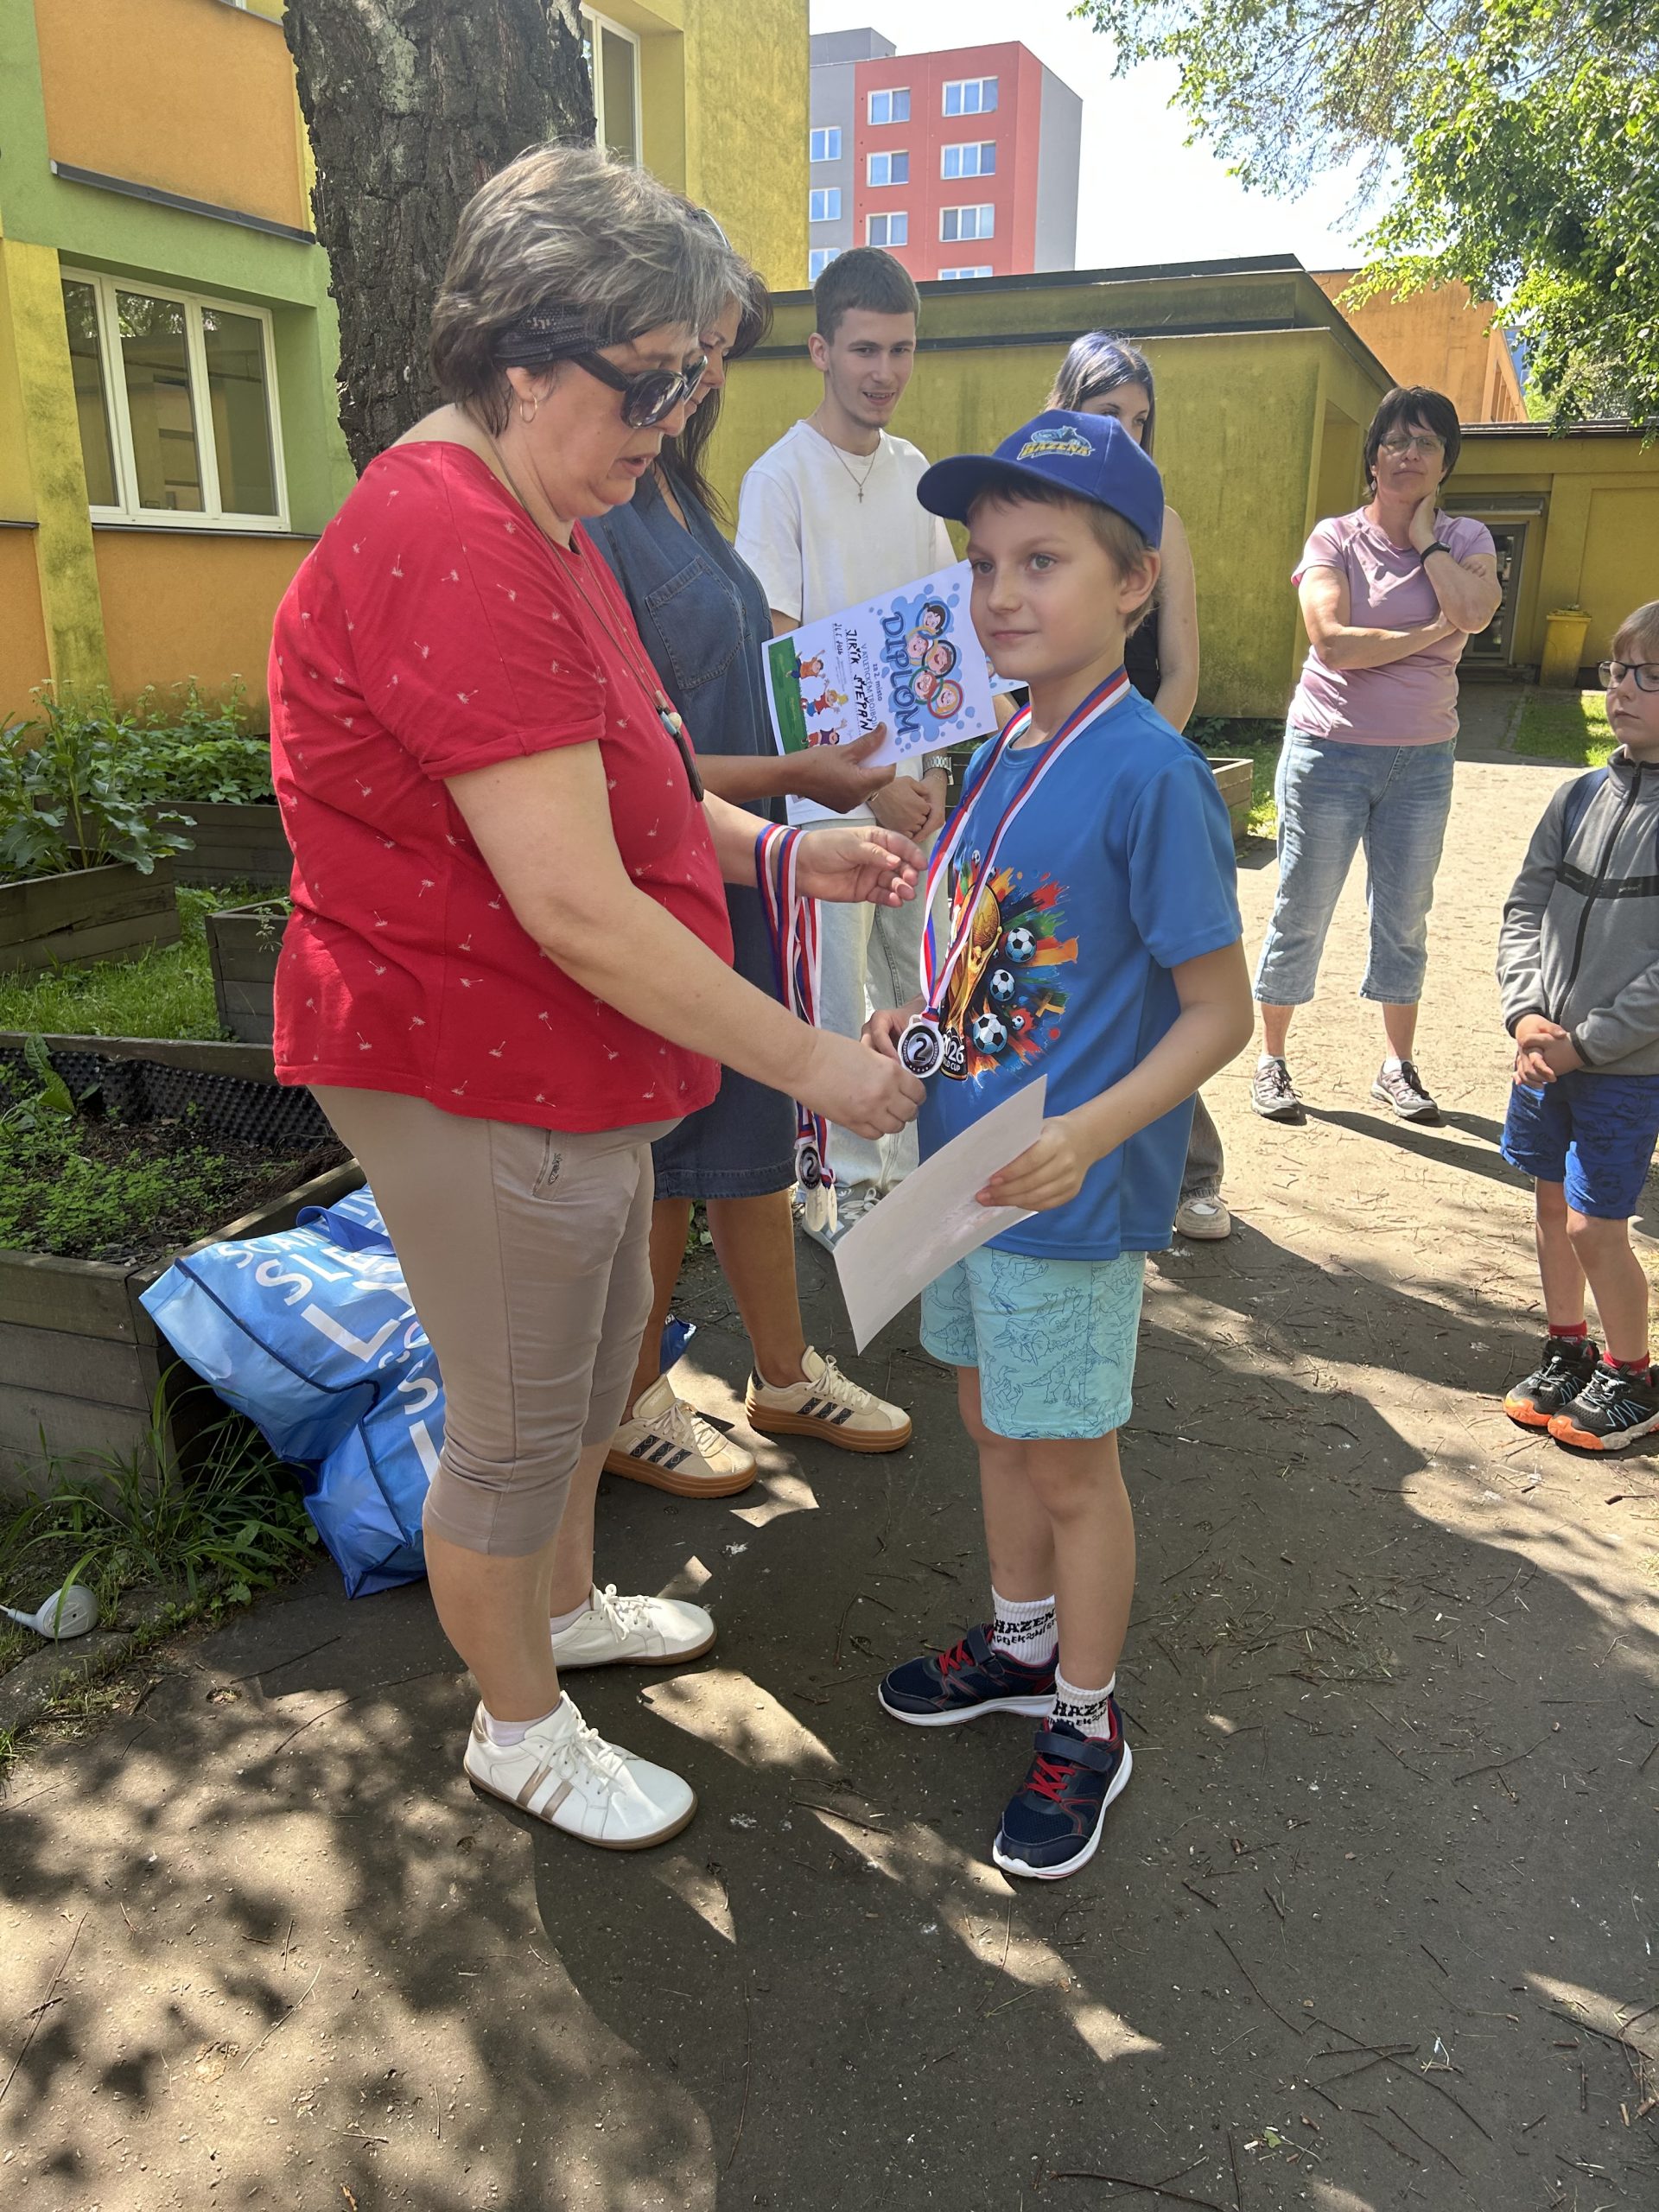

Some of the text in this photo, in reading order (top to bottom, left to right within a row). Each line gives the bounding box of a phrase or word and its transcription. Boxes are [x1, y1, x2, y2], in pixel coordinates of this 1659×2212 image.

[881, 610, 920, 735] DIPLOM
[874, 680, 883, 702] místo
[913, 1037, 928, 1062] 2
[950, 1062, 961, 1072] CUP
[806, 1156, 815, 1178] 2
